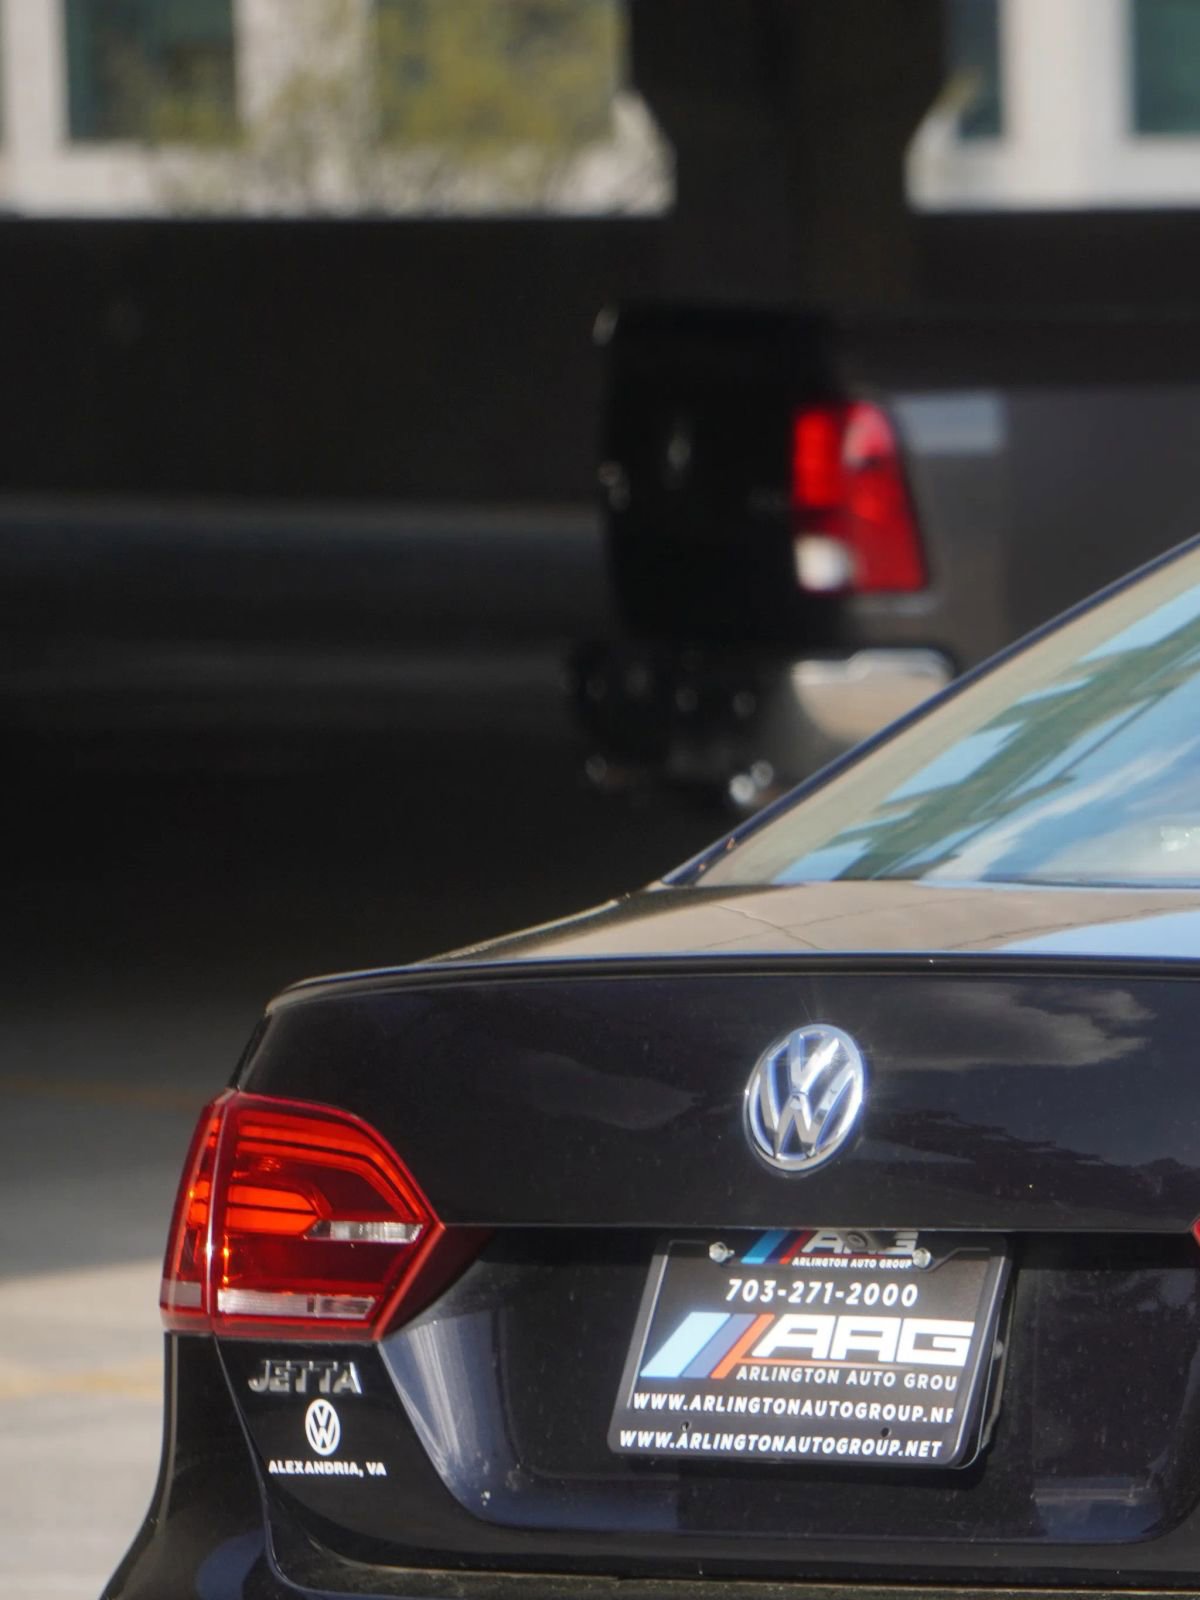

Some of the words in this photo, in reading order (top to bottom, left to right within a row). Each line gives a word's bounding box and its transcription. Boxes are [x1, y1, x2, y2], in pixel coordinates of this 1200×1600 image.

[792, 1257, 848, 1268] ARLINGTON
[850, 1259, 877, 1269] AUTO
[879, 1259, 914, 1270] GROUP
[726, 1279, 919, 1308] 703-271-2000
[752, 1313, 975, 1367] AAG
[248, 1360, 362, 1394] JETTA
[736, 1365, 839, 1386] ARLINGTON
[846, 1370, 896, 1388] AUTO
[620, 1430, 943, 1458] WWW.ARLINGTONAUTOGROUP.NET
[268, 1460, 364, 1478] ALEXANDRIA,
[366, 1462, 387, 1476] VA
